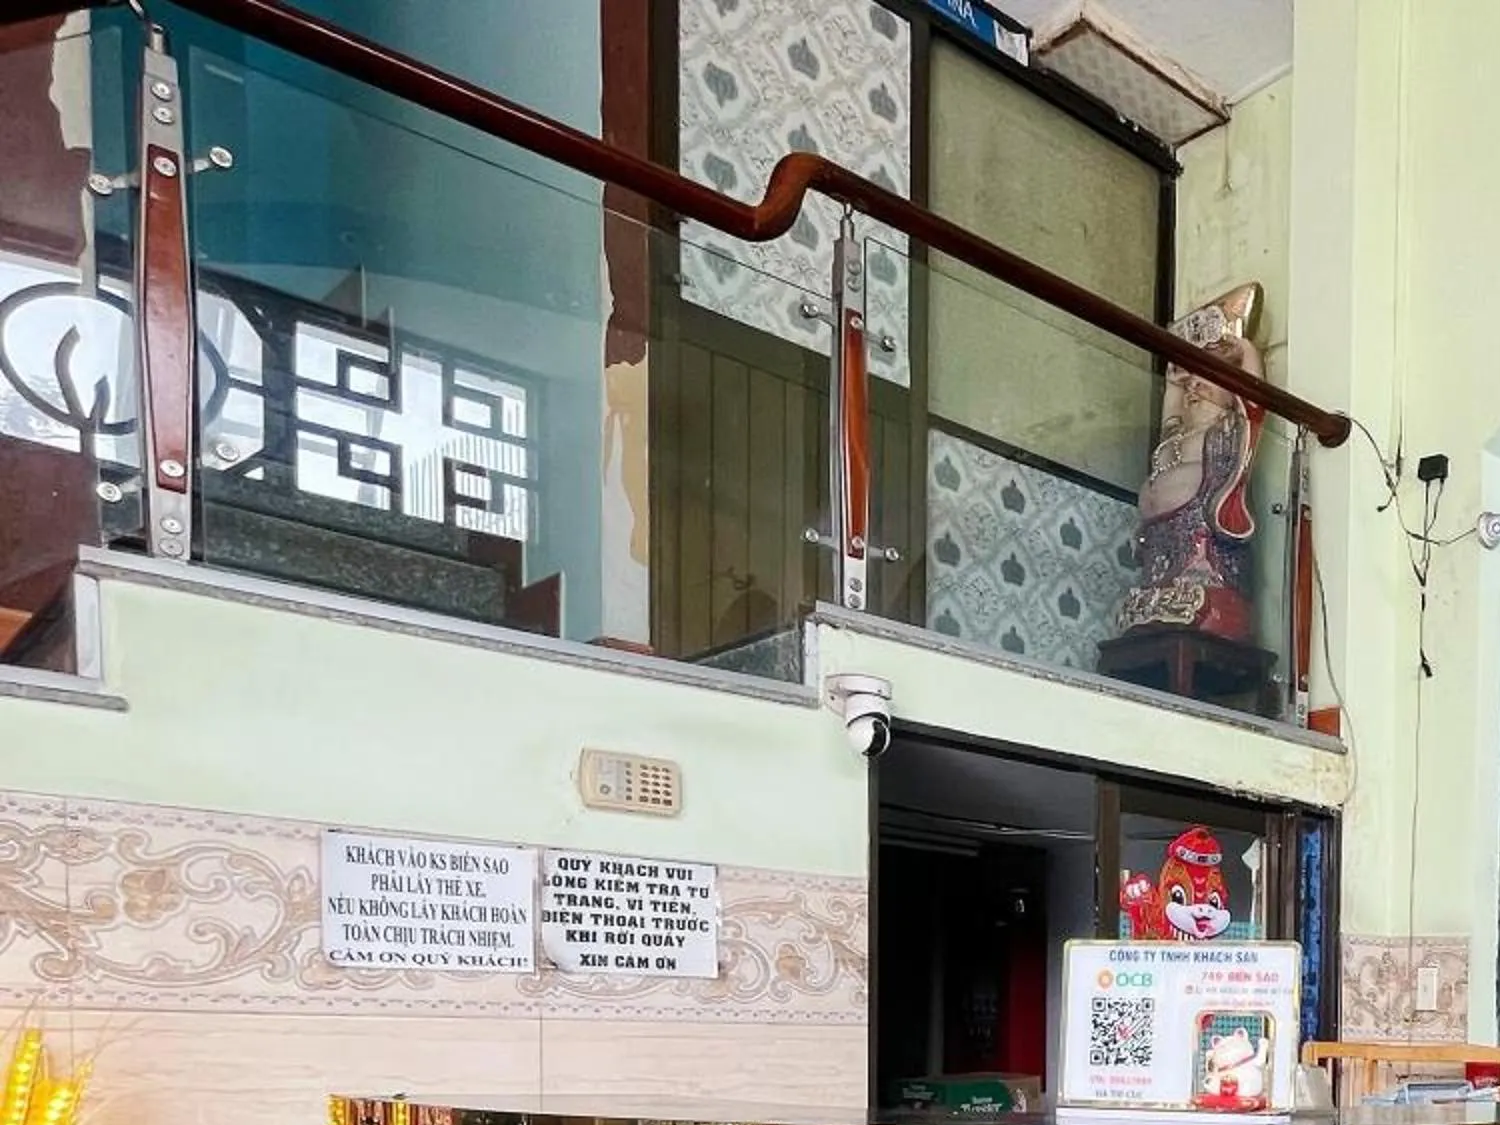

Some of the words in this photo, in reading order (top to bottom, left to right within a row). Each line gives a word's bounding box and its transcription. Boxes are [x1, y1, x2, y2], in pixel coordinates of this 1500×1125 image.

[429, 852, 447, 871] KS
[483, 855, 509, 875] SAO
[665, 867, 693, 881] VUI
[646, 883, 681, 897] TRA
[565, 930, 597, 943] KHI
[580, 953, 609, 967] XIN
[1144, 950, 1156, 962] TY
[1116, 972, 1152, 987] OCB
